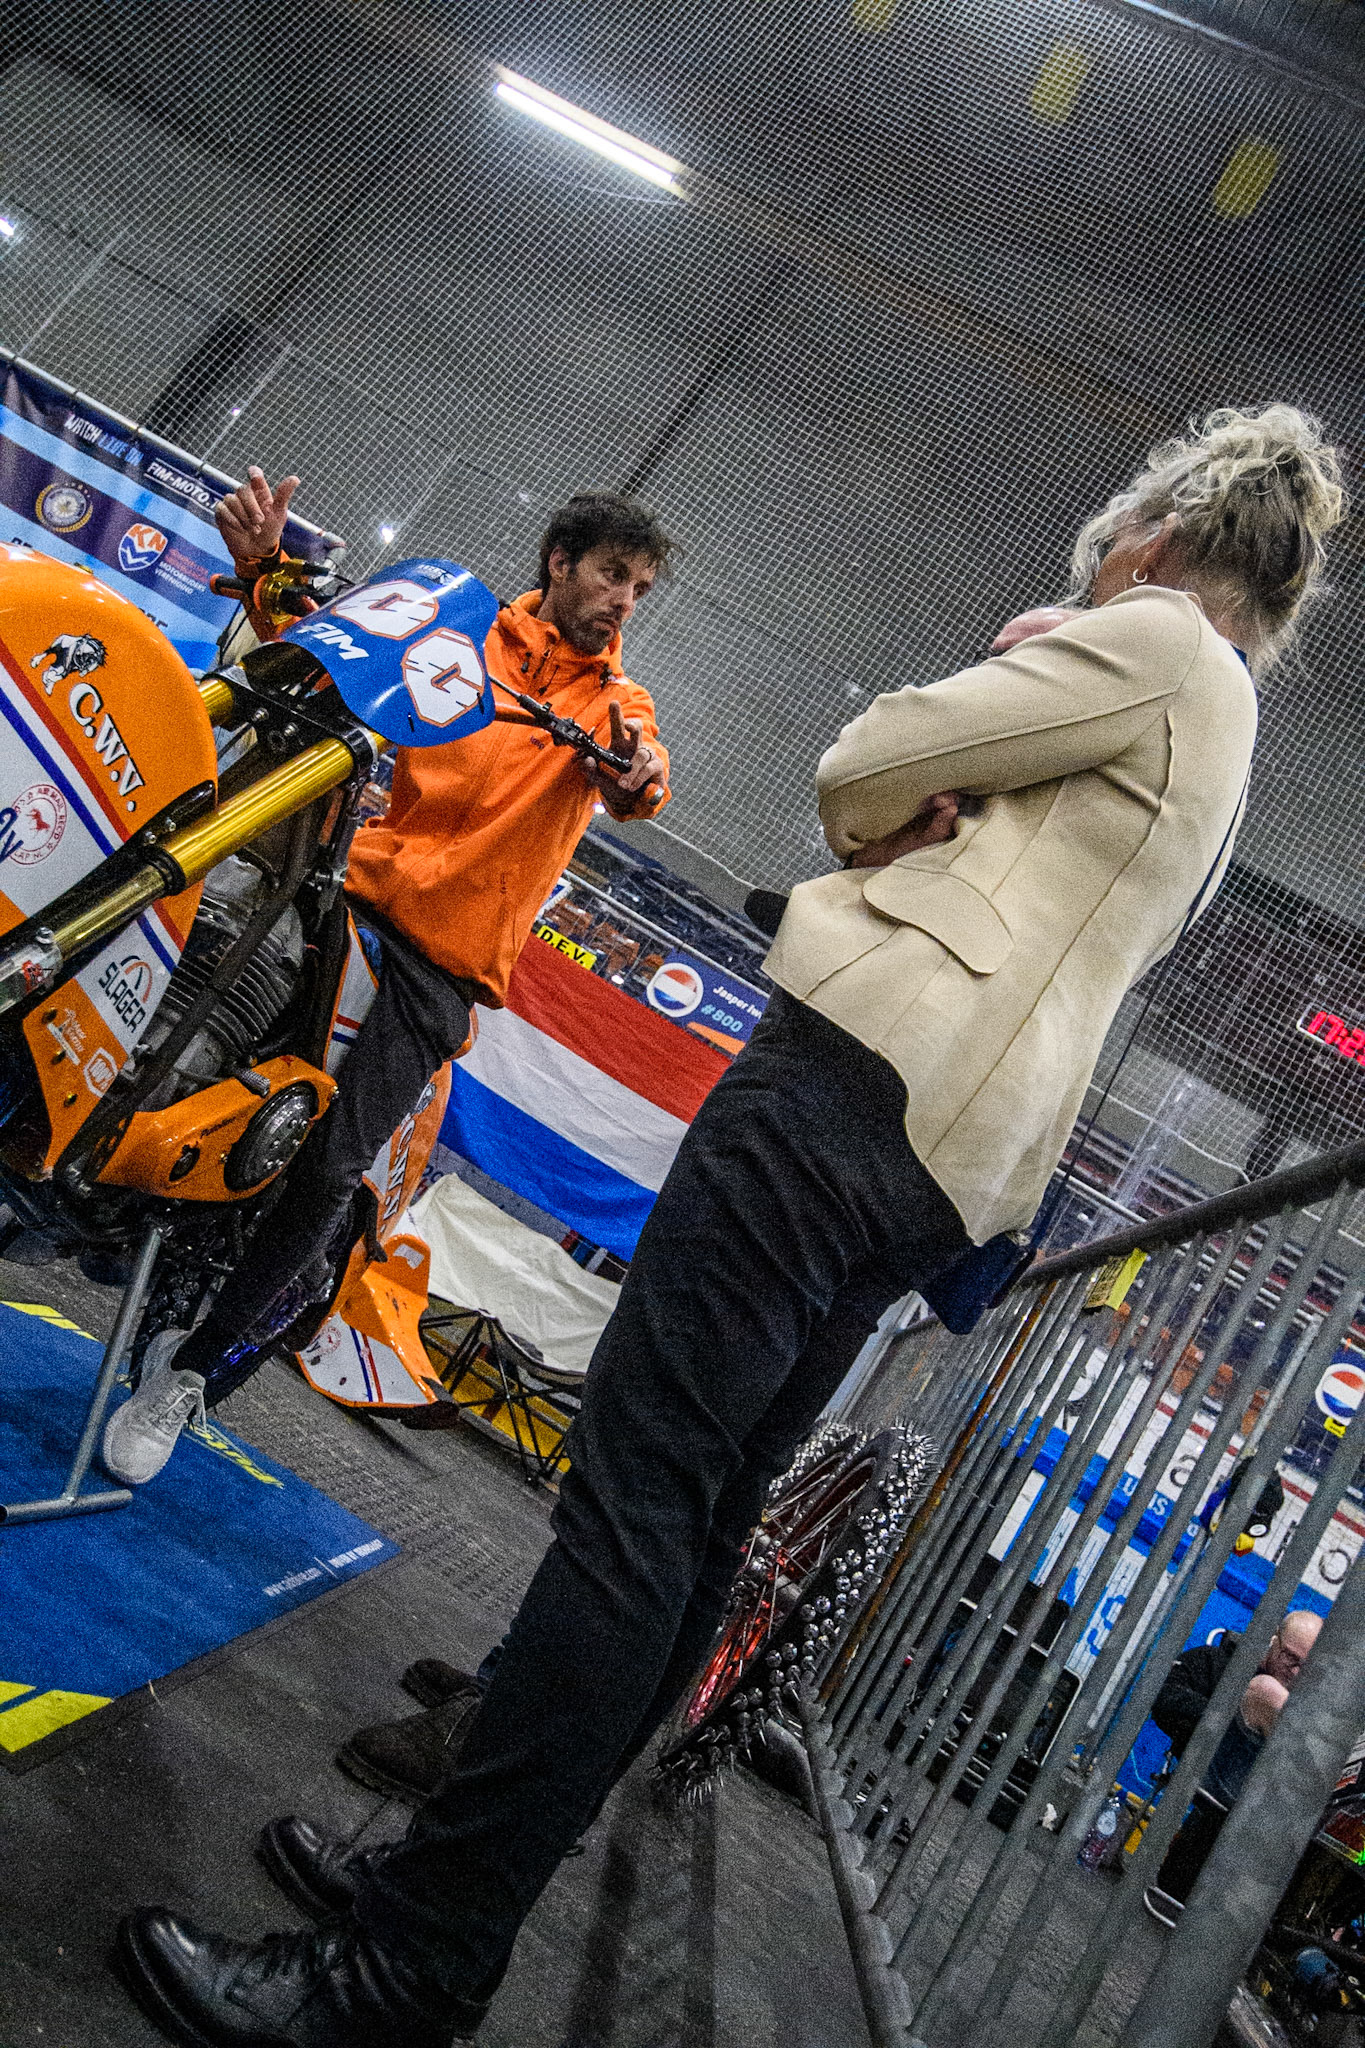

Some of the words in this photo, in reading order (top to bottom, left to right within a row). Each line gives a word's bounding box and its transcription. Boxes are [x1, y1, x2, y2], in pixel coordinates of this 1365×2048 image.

[64, 414, 103, 443] WATCH
[297, 622, 369, 660] FIM
[69, 682, 145, 812] C.W.V.
[539, 928, 586, 965] D.E.V.
[98, 962, 146, 1033] SLAGER
[712, 986, 749, 1010] Jasper
[700, 1004, 744, 1032] #800
[1308, 1011, 1365, 1066] 17:2
